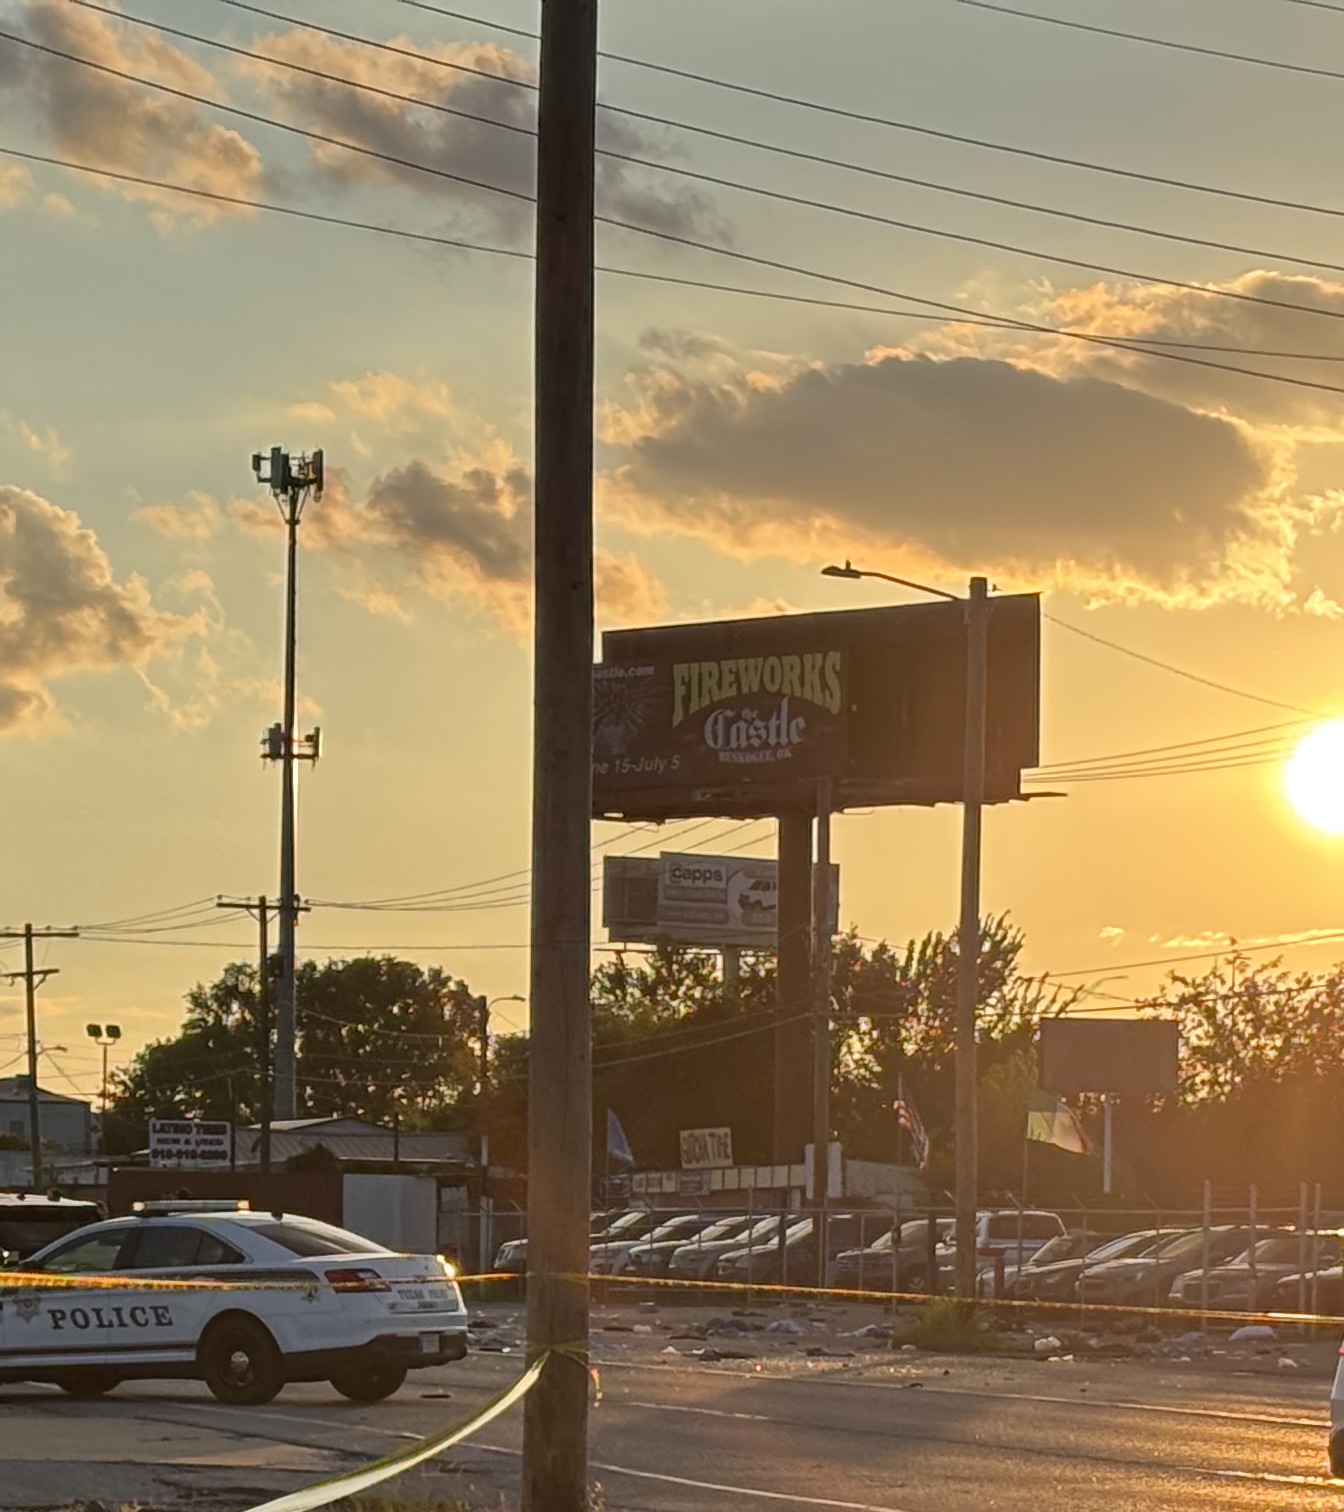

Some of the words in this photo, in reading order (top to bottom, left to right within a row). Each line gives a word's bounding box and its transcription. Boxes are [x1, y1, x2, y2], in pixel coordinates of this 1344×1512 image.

[592, 665, 655, 680] astle.com
[672, 652, 841, 728] FIREWORKS
[704, 695, 806, 751] Castle
[614, 755, 668, 775] 15-July
[670, 754, 681, 771] 5
[47, 1305, 174, 1330] POLICE
